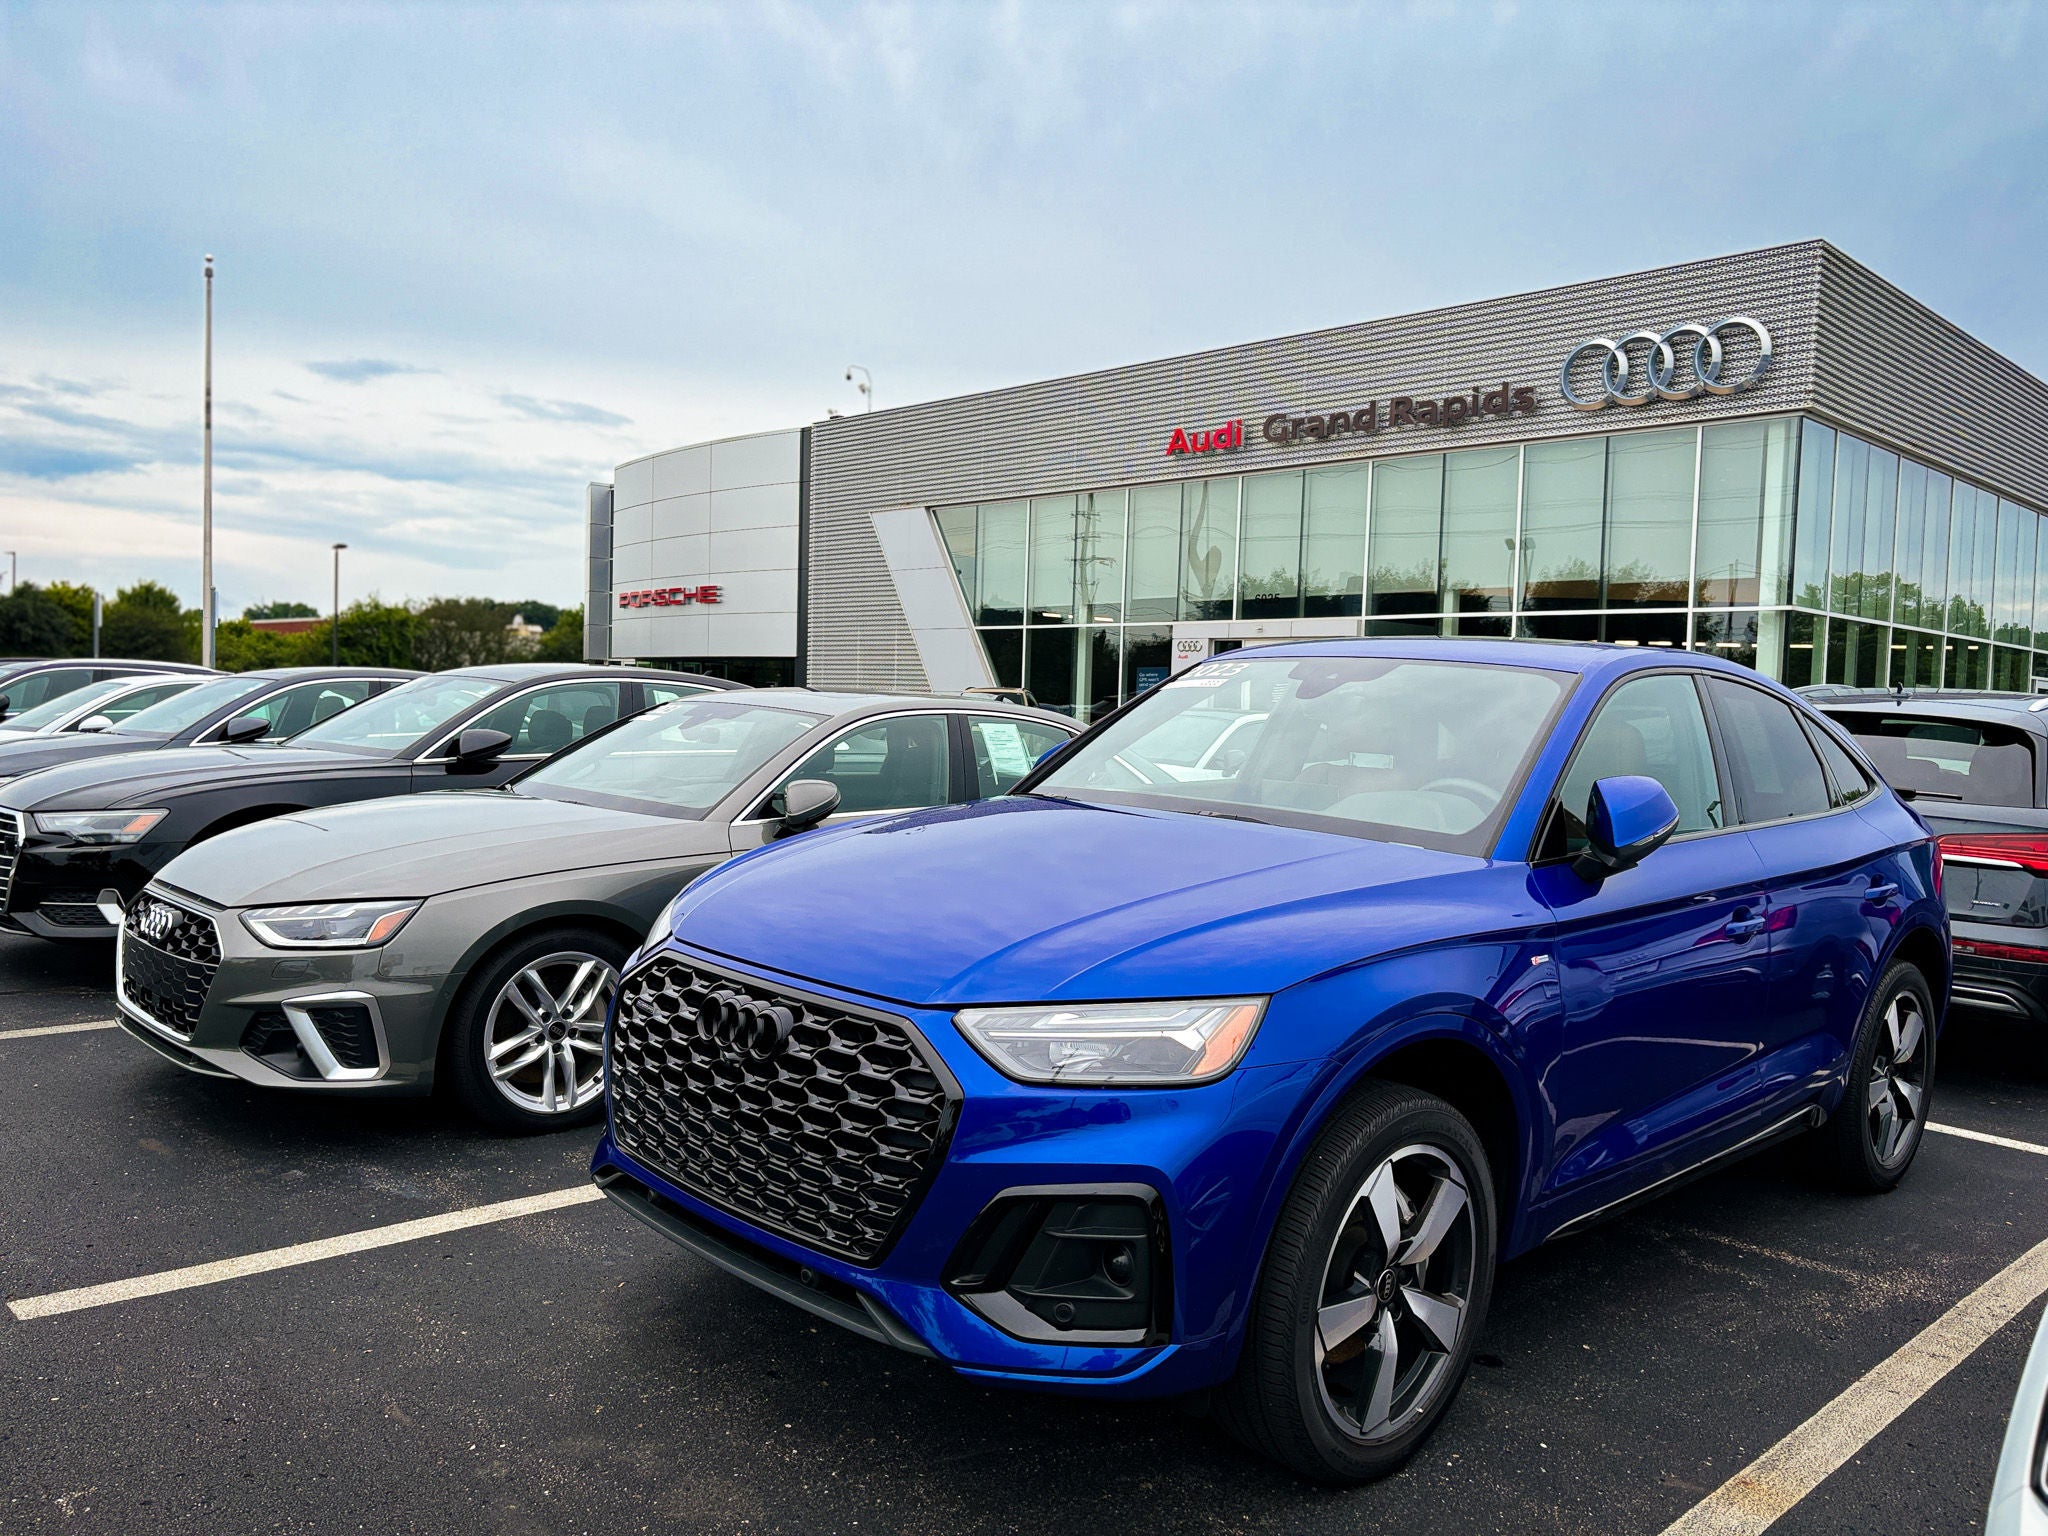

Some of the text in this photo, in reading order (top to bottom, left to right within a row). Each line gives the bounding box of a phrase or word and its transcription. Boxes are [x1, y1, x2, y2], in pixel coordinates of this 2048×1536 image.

[1165, 382, 1537, 456] Audi Grand Rapids
[619, 586, 722, 608] PORSCHE
